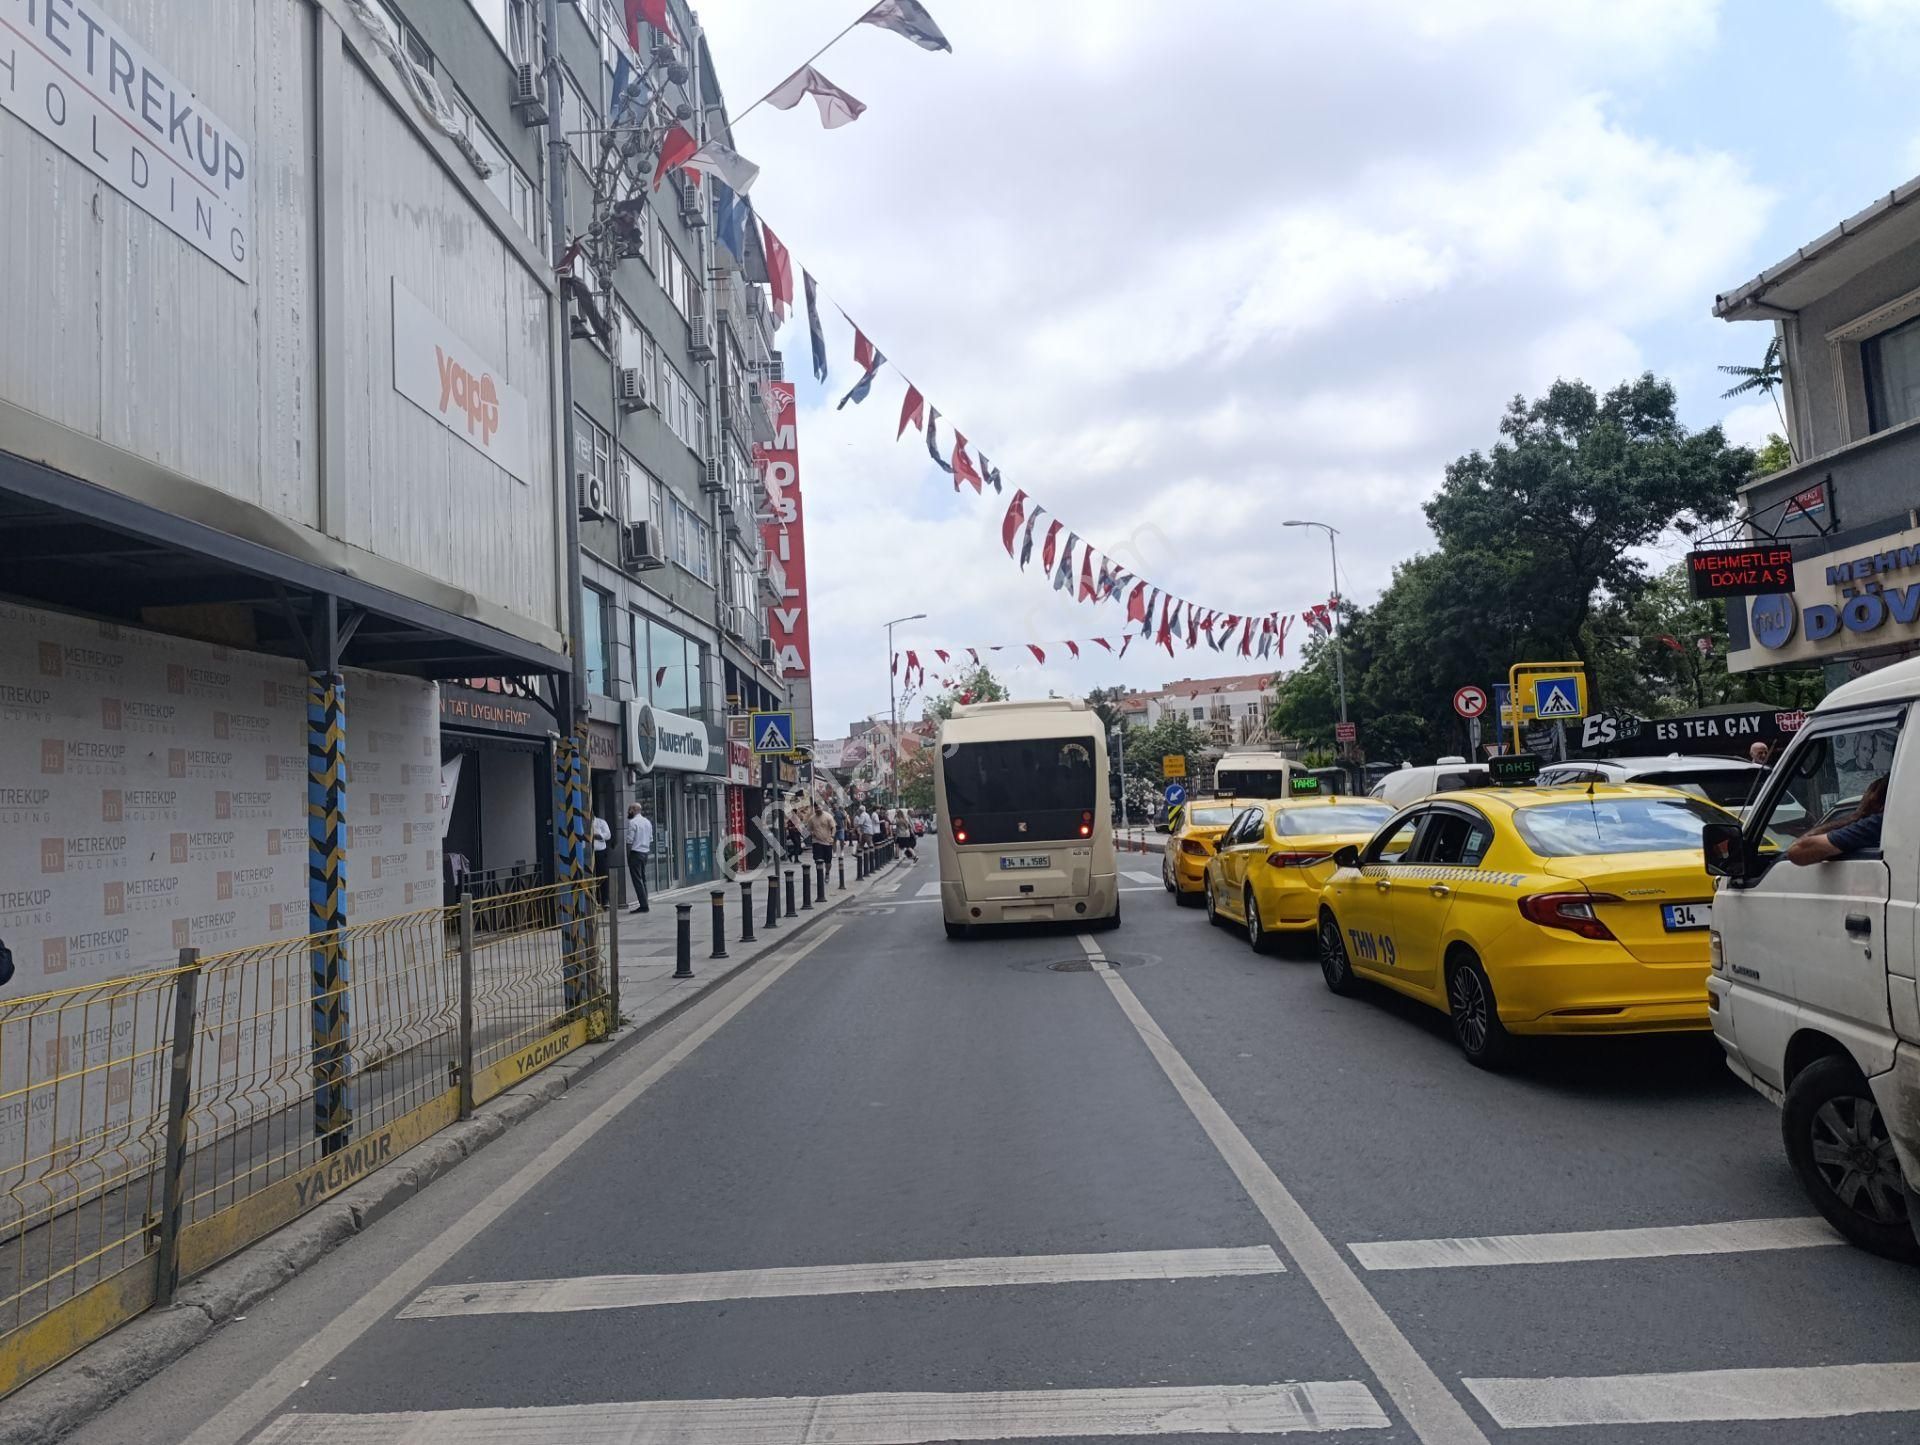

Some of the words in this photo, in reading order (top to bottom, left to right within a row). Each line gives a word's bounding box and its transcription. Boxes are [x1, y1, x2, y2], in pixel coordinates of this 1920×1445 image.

[15, 0, 245, 190] ETREKÜP
[435, 344, 499, 447] yapp
[1694, 551, 1792, 571] MEHMETLER
[1762, 570, 1773, 583] A
[1657, 723, 1678, 740] ES
[1684, 719, 1719, 738] TEA
[1725, 716, 1761, 737] ÇAY
[1674, 906, 1696, 925] 34
[1348, 928, 1378, 961] THN
[1379, 934, 1396, 966] 19
[295, 1133, 392, 1206] YAĞMUR
